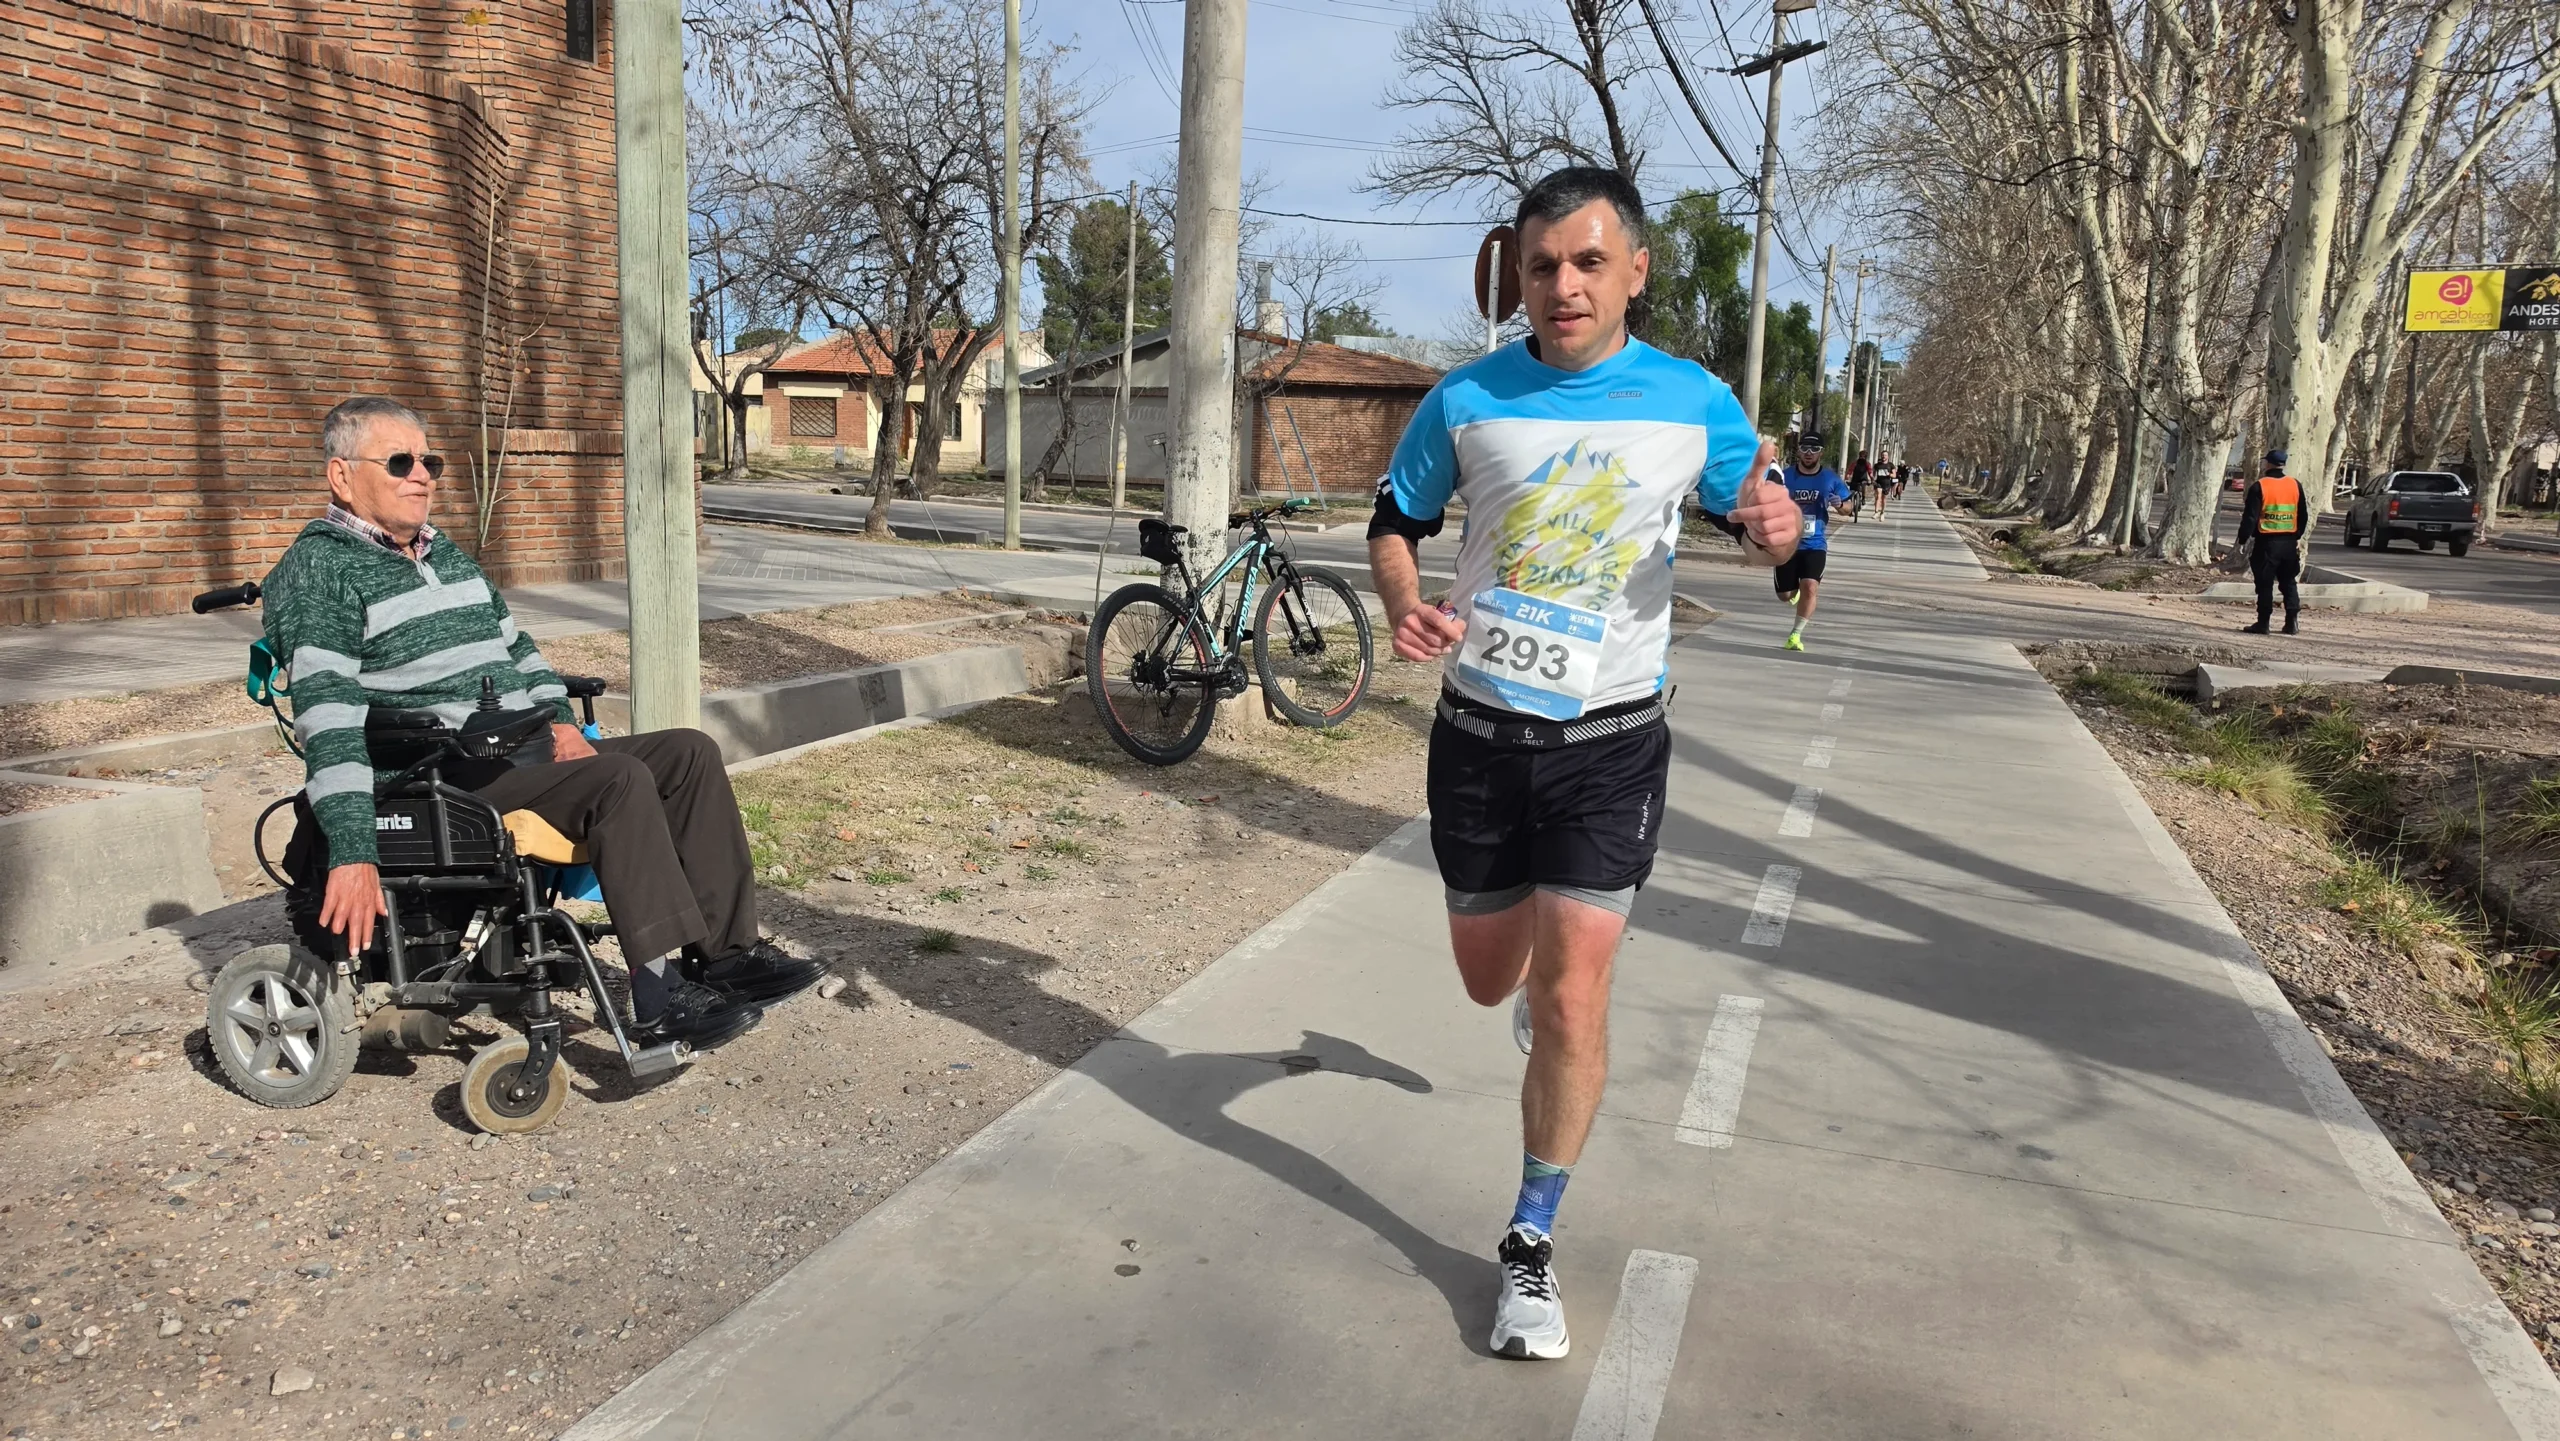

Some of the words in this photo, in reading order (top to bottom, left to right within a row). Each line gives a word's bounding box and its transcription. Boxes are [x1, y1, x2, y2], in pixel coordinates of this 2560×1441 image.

[2529, 317, 2559, 326] HOTE
[1515, 603, 1555, 625] 21K
[1481, 626, 1570, 681] 293
[1519, 693, 1551, 706] MORENO
[1512, 738, 1544, 746] FLIPBELT
[375, 813, 413, 830] erits
